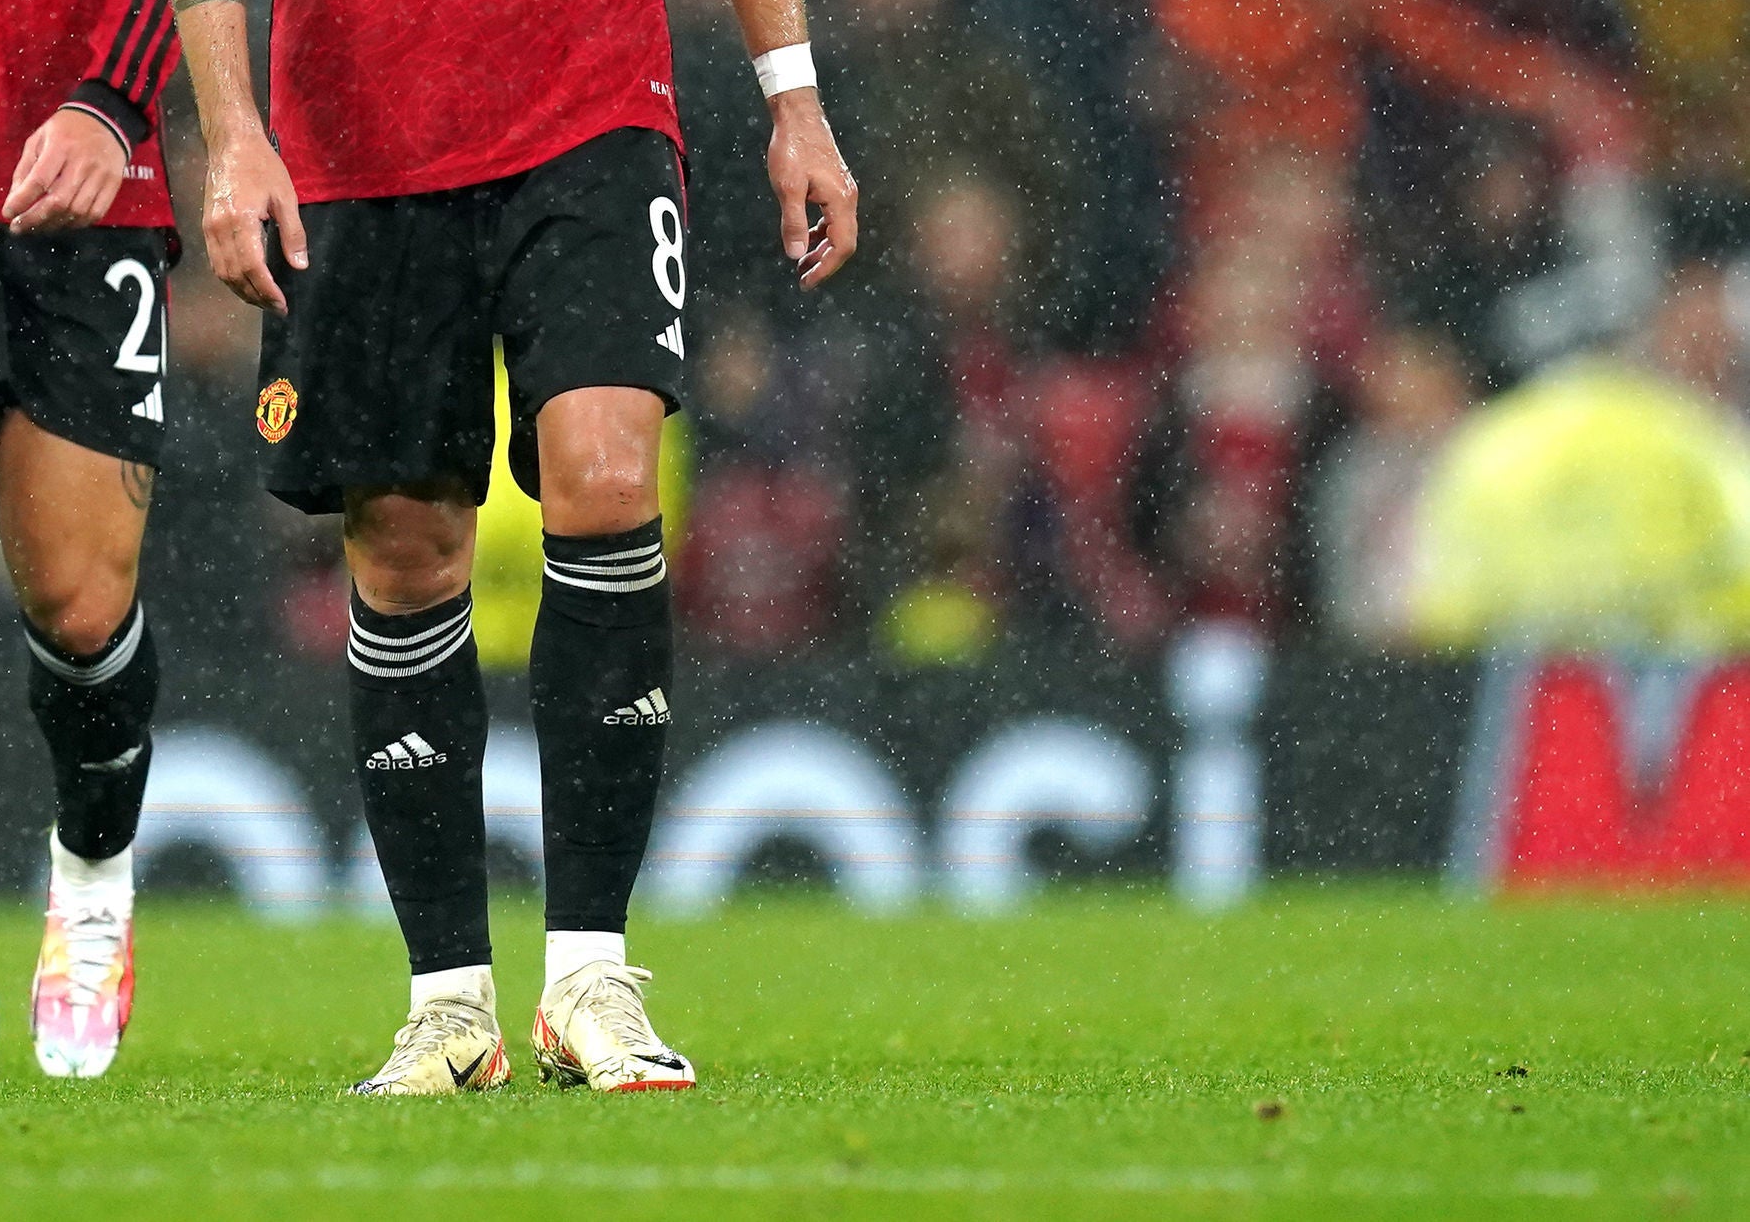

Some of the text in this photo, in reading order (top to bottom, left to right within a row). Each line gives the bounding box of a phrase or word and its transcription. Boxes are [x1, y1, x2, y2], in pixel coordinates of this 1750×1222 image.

[648, 195, 686, 311] 8
[602, 709, 673, 726] adidas
[365, 752, 448, 771] adidas
